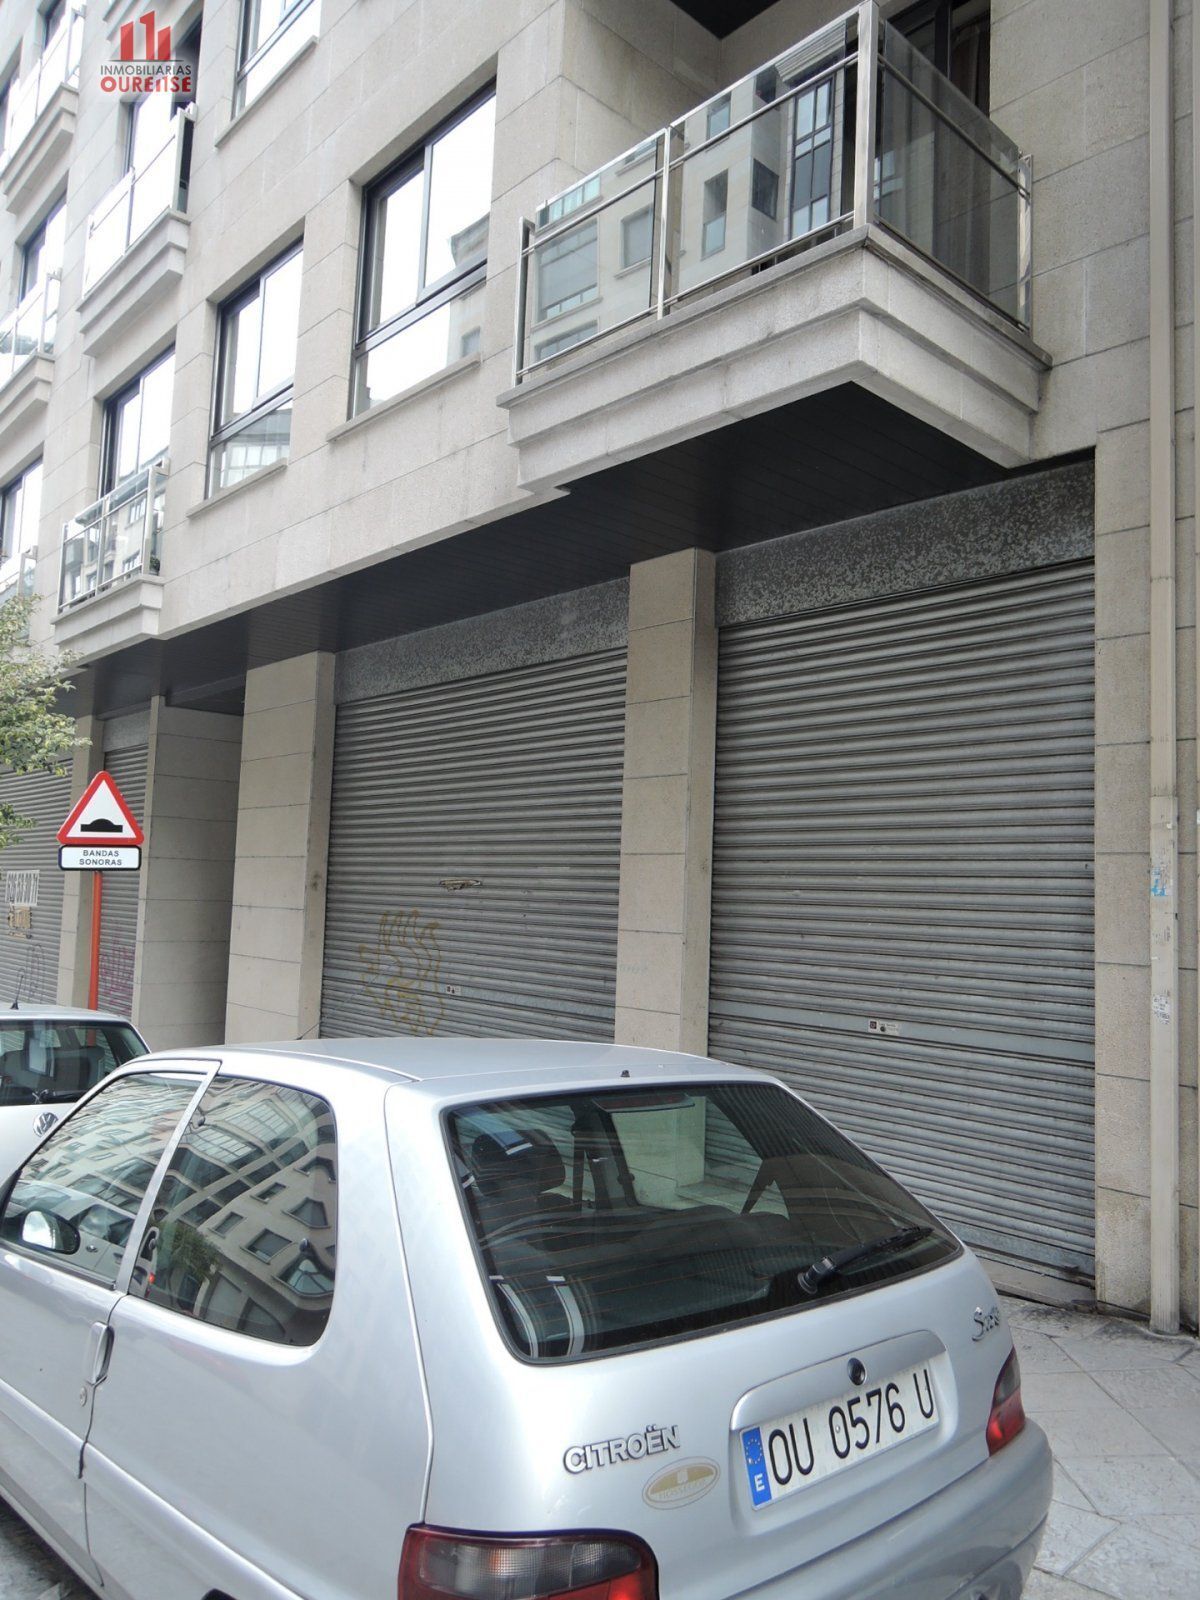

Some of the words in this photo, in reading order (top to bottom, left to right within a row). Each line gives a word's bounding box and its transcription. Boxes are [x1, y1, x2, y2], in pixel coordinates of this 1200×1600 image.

[79, 858, 123, 866] SONORAS
[82, 849, 120, 857] BANDAS
[767, 1417, 815, 1486] OU
[828, 1382, 906, 1459] 0576
[912, 1368, 935, 1419] U
[562, 1424, 681, 1475] CITROËN
[754, 1473, 766, 1492] E
